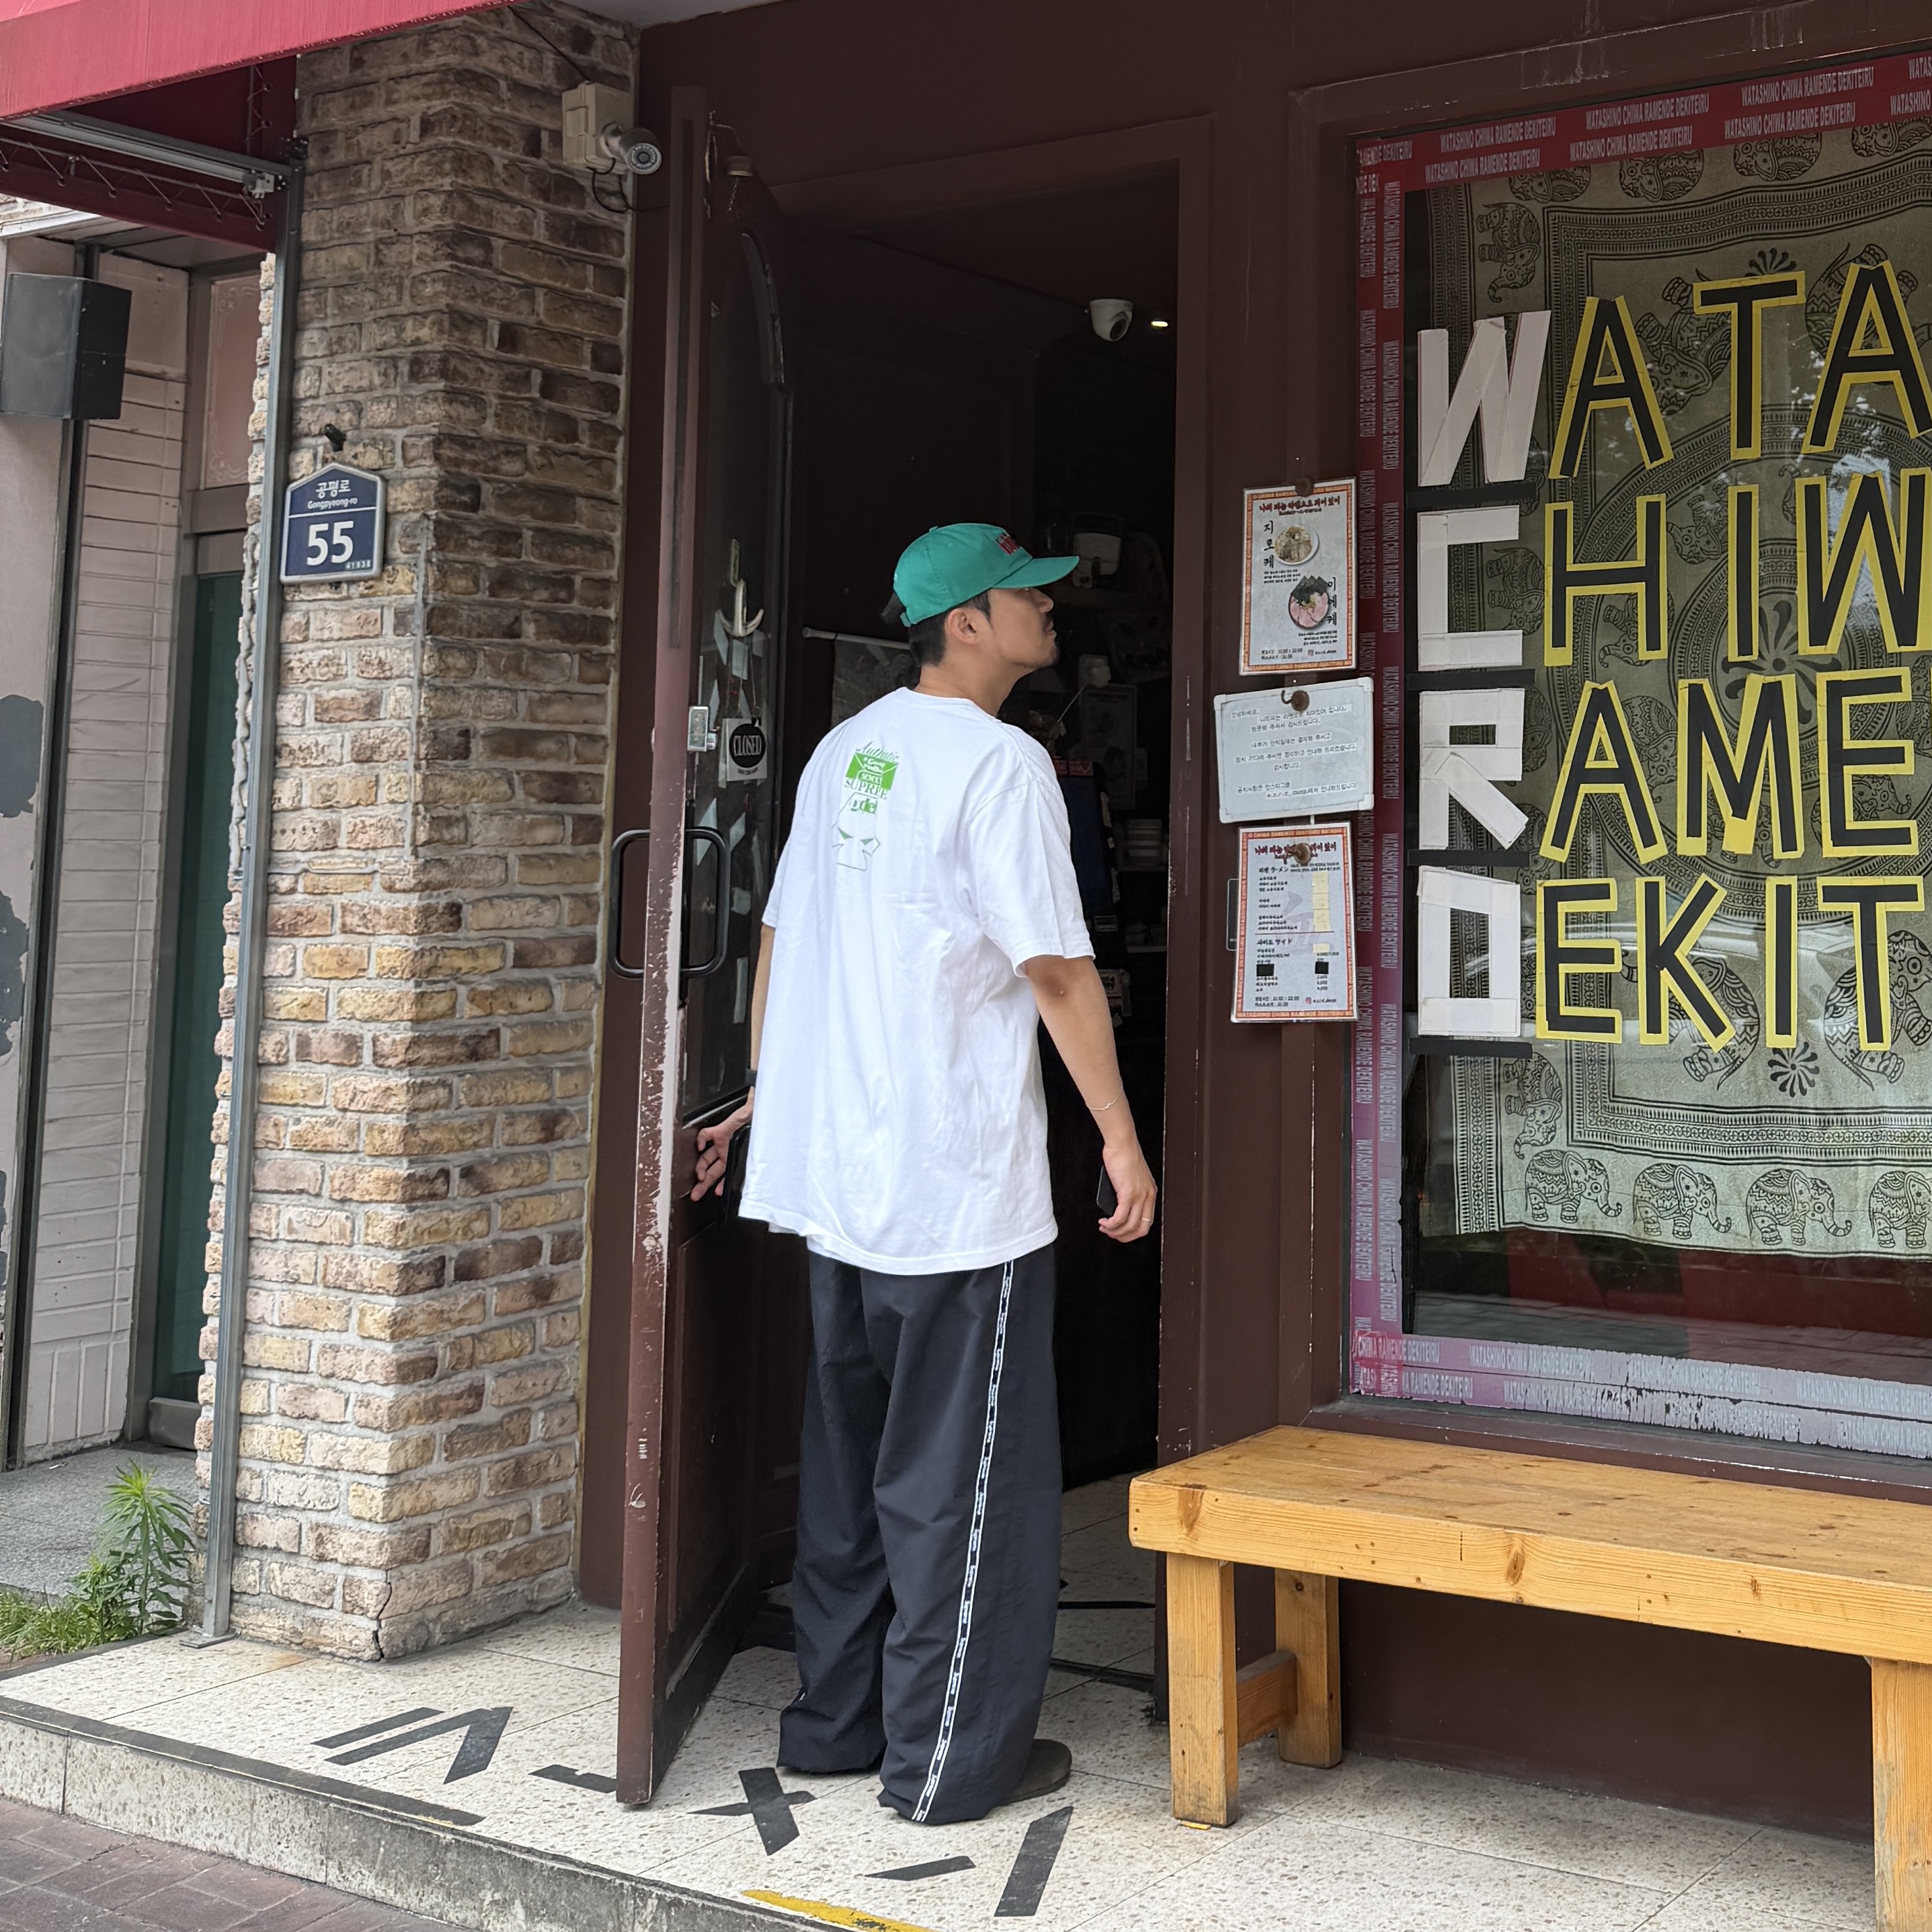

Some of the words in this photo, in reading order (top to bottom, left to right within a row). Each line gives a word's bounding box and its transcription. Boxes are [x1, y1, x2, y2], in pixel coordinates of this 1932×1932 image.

[1742, 81, 1779, 106] WATASHINO
[1781, 78, 1802, 100] CHIWA
[1804, 73, 1837, 97] RAMENDE
[1838, 67, 1874, 92] DEKITEIRU
[1586, 107, 1621, 130] WATASHINO
[1623, 104, 1643, 124] CHIWA
[1645, 99, 1675, 121] RAMENDE
[1676, 93, 1709, 117] DEKITEIRU
[1725, 116, 1761, 139] WATASHINO
[1763, 112, 1785, 134] CHIWA
[1786, 108, 1818, 131] RAMENDE
[1820, 102, 1855, 126] DEKITEIRU
[1570, 138, 1605, 161] WATASHINO
[1606, 135, 1626, 157] CHIWA
[1628, 130, 1657, 153] RAMENDE
[1659, 126, 1692, 149] DEKITEIRU
[307, 497, 358, 510] Gongpyeong-ro
[315, 479, 351, 499] 공평로
[307, 520, 354, 566] 55
